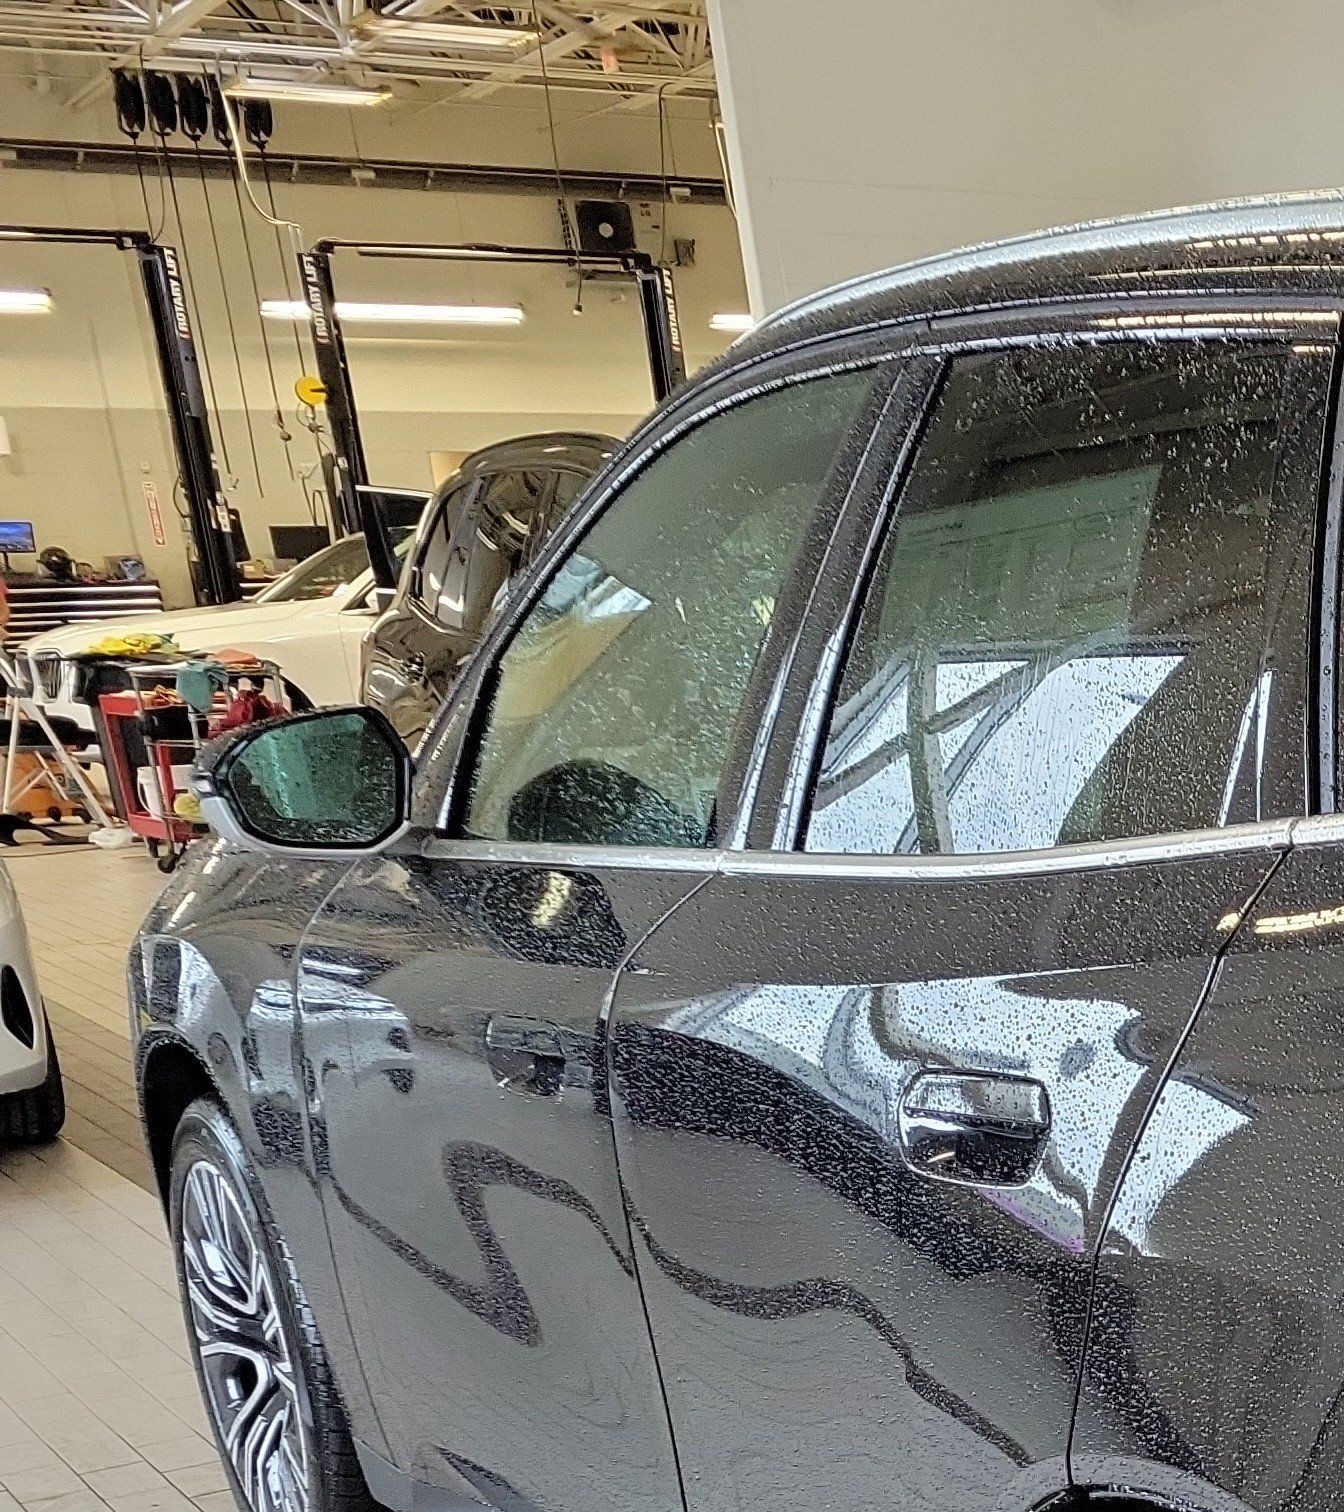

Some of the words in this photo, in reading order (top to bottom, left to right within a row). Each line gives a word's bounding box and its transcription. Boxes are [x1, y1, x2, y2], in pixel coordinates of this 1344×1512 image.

[163, 247, 179, 278] LIFT
[302, 255, 318, 282] LIFT
[662, 268, 673, 295] LIFT
[169, 279, 191, 332] ROTARY
[308, 284, 329, 336] ROTARY
[666, 297, 681, 345] ROTARY
